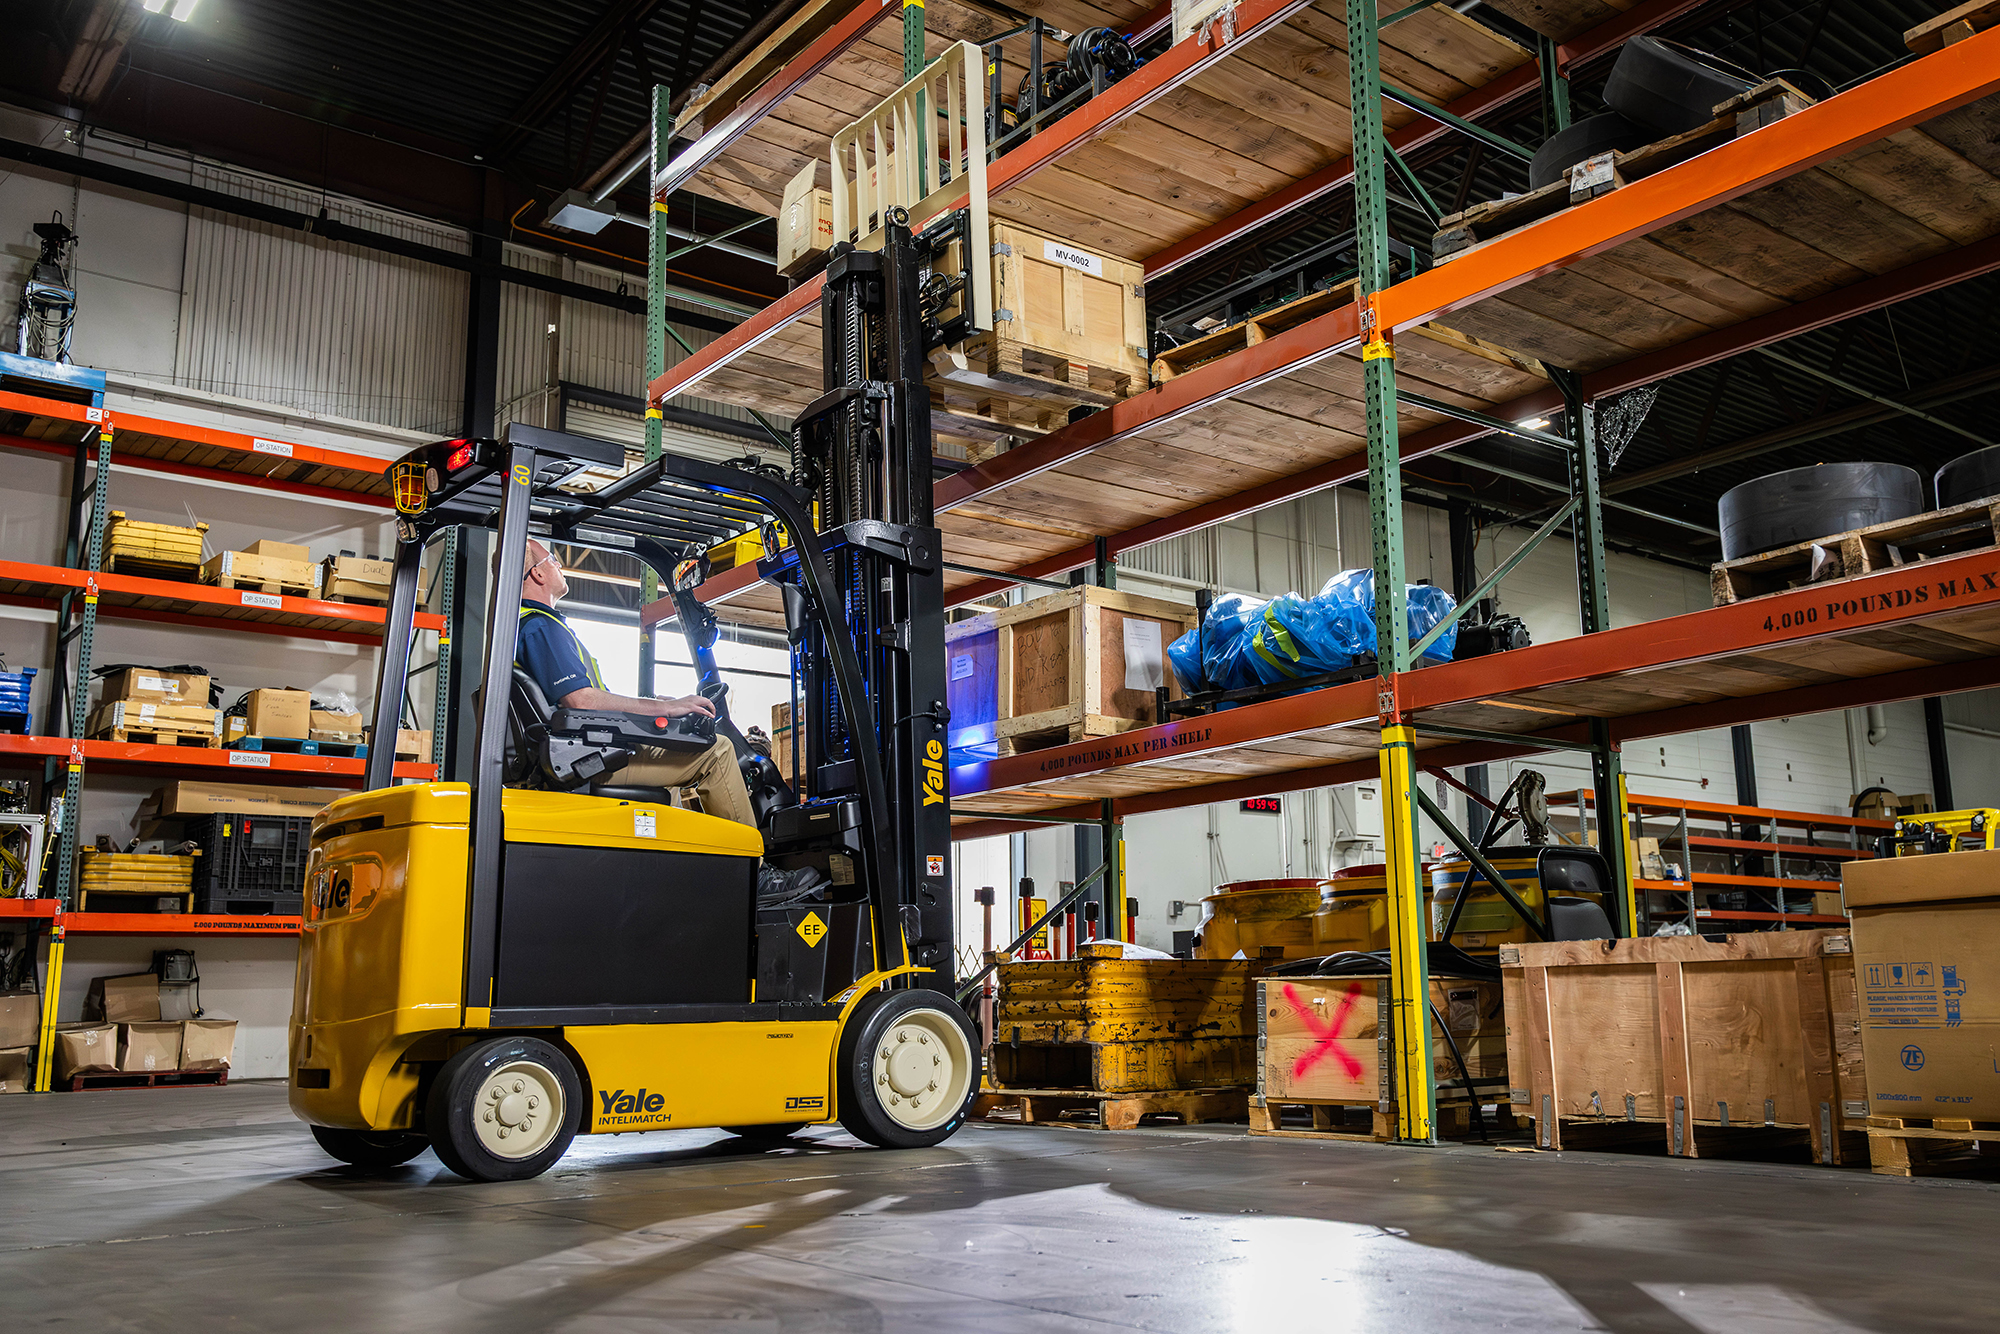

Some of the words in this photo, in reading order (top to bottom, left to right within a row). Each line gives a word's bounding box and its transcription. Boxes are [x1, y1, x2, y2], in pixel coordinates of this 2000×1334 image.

[1055, 249, 1090, 268] MV-0002
[90, 411, 99, 419] 2
[255, 441, 265, 450] OP
[265, 443, 292, 454] STATION
[513, 464, 531, 486] 60
[243, 594, 254, 603] OP
[254, 596, 281, 606] STATION
[1826, 585, 1929, 620] POUNDS
[1937, 571, 2000, 600] MAX
[1017, 624, 1044, 658] BOD
[1067, 751, 1112, 768] POUNDS
[1114, 743, 1141, 759] MAX
[1143, 736, 1169, 753] PER
[1171, 728, 1213, 747] SHELF
[231, 755, 242, 763] OP
[242, 755, 269, 764] STATION
[922, 739, 944, 807] Yale
[243, 922, 282, 930] MAXIMUM
[282, 922, 297, 930] PER
[804, 924, 820, 935] EE
[1902, 1049, 1923, 1067] ZF
[598, 1088, 666, 1115] Yale
[785, 1095, 824, 1110] DSS
[1876, 1093, 1908, 1101] 1200x800
[598, 1113, 672, 1126] INTELIMATCH
